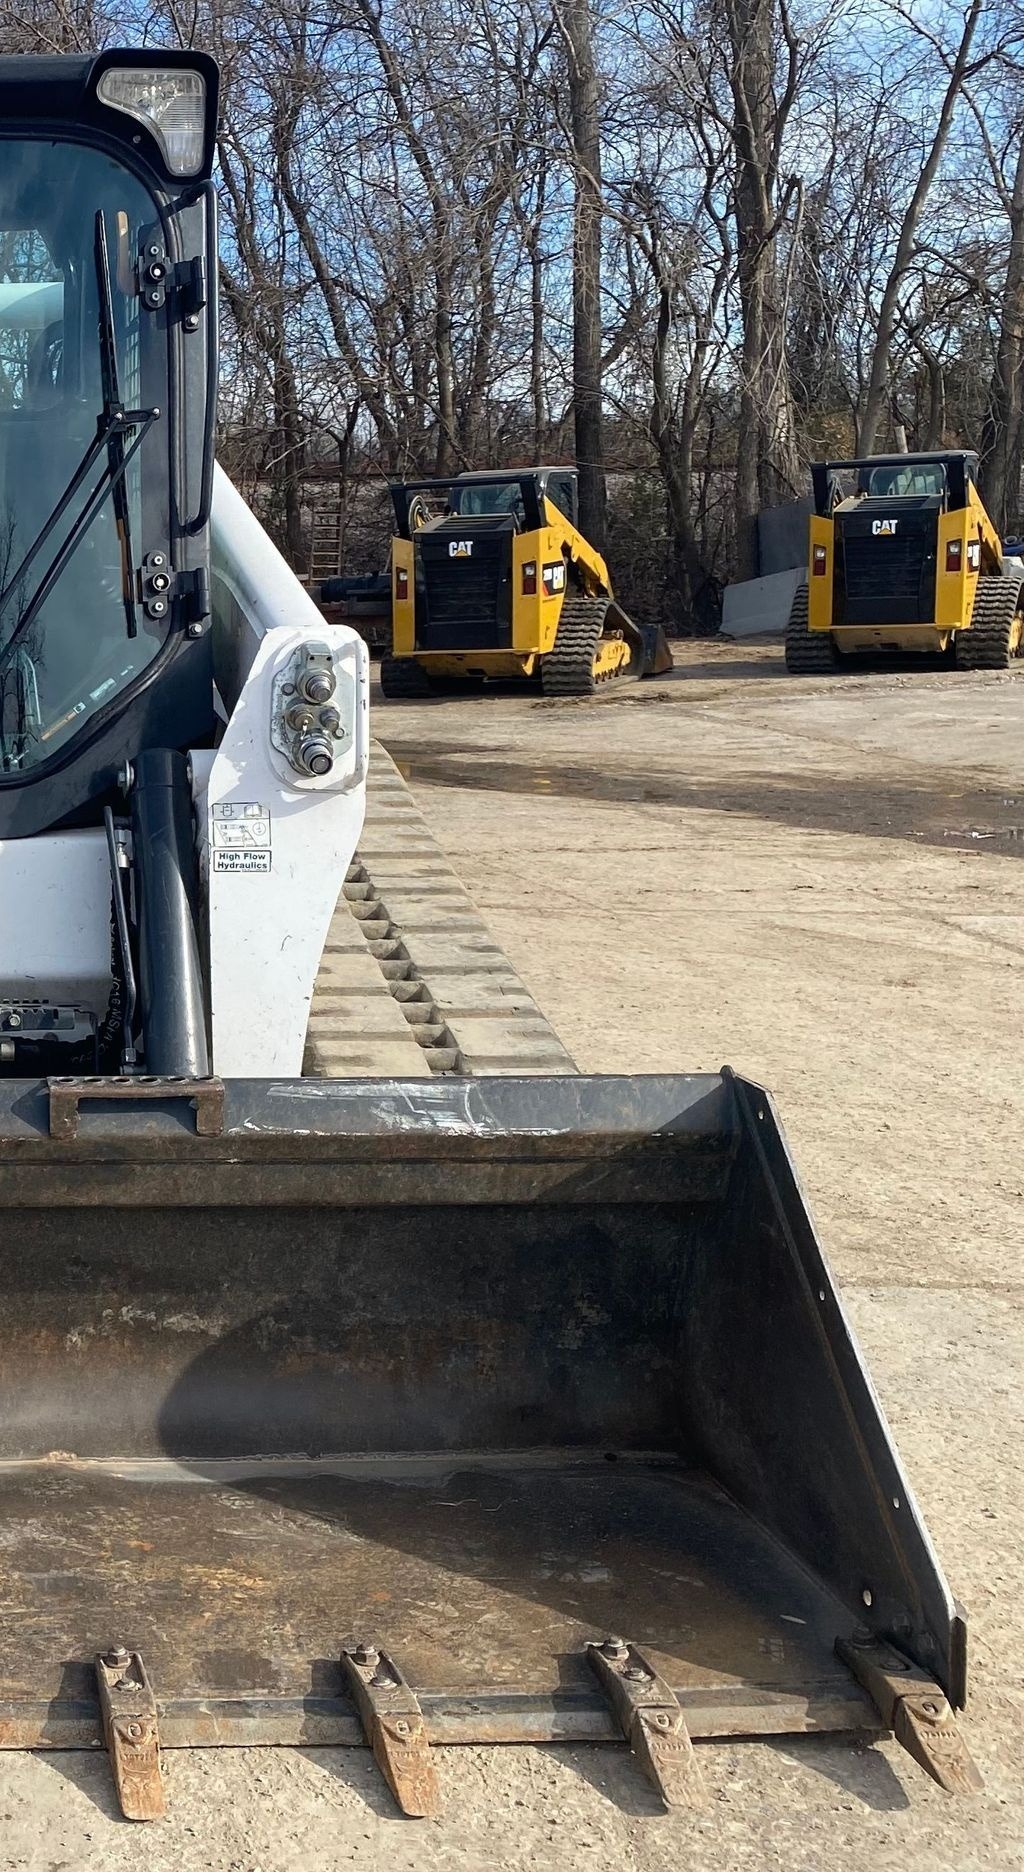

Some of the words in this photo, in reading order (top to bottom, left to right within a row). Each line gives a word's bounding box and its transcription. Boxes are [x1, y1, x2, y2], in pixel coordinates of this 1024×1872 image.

[872, 520, 898, 535] CAT
[448, 541, 474, 557] CAT
[219, 853, 240, 861] High
[217, 862, 268, 870] Hydraulics
